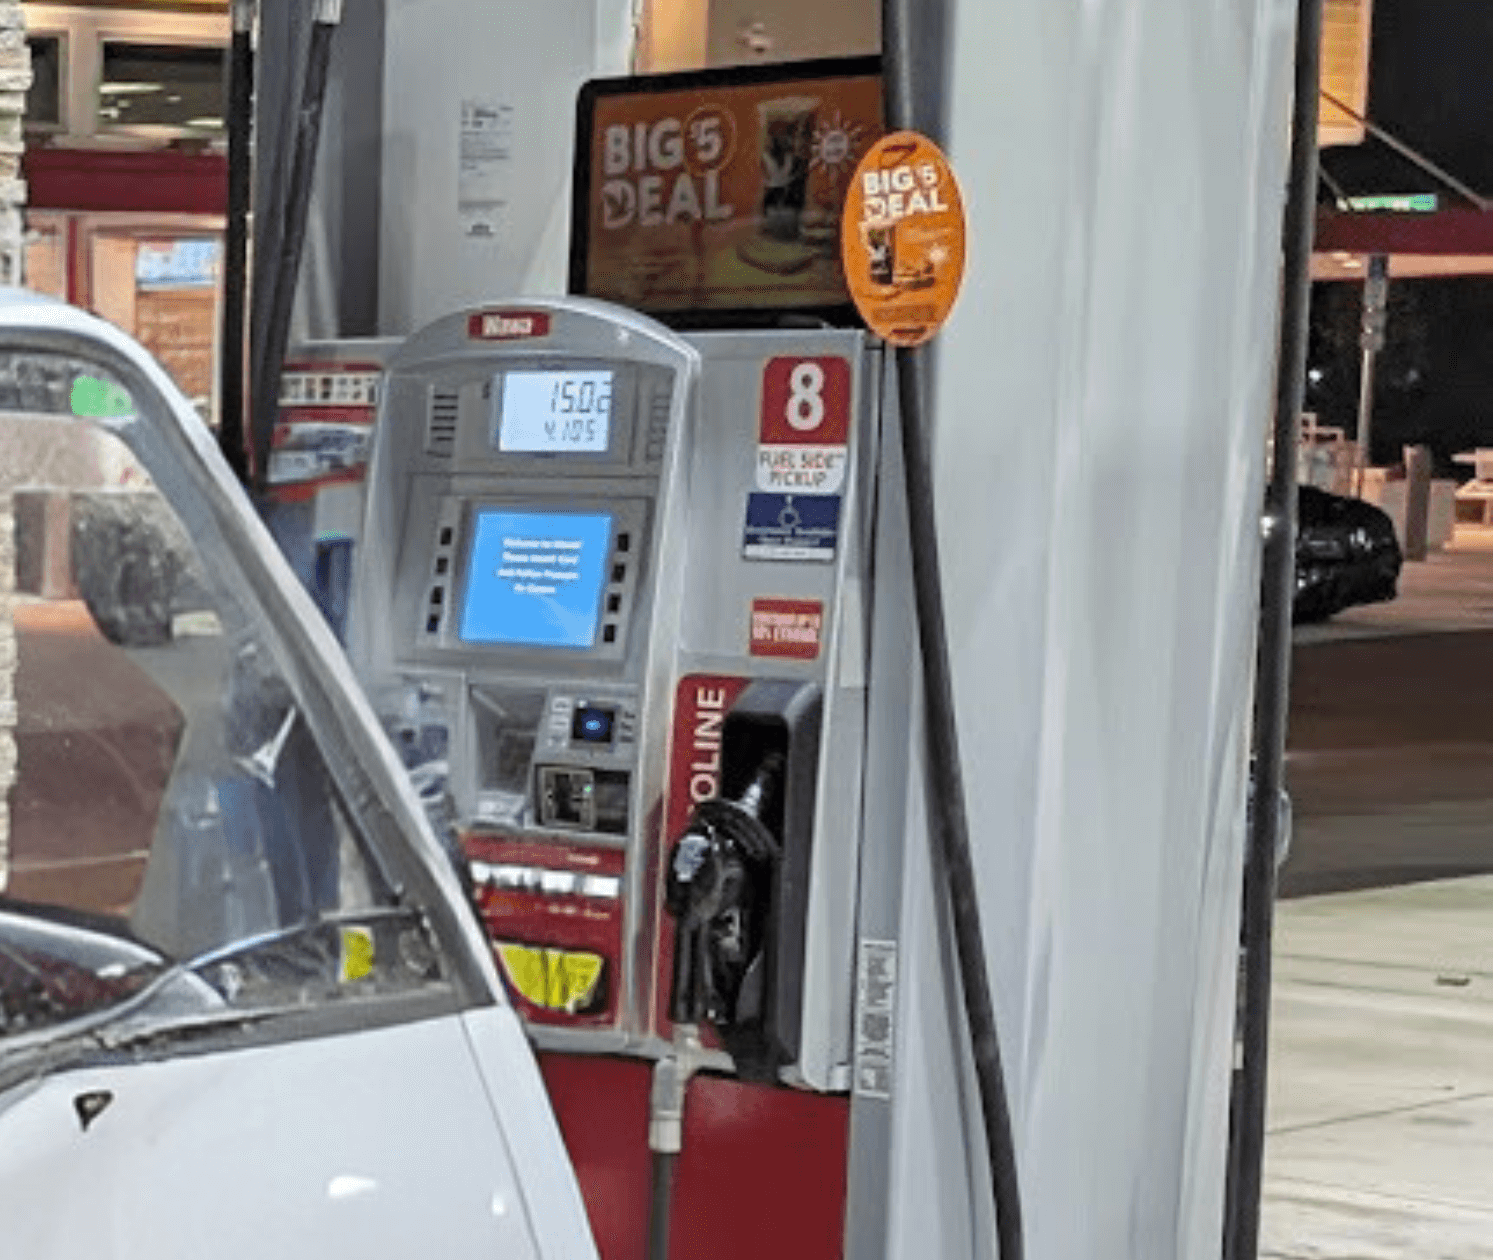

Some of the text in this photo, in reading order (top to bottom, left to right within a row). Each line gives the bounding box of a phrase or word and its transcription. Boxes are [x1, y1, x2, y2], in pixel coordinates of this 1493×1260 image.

[604, 117, 684, 174] BIG
[603, 169, 734, 229] DEAL
[863, 166, 914, 195] BIG
[863, 188, 948, 222] DEAL
[786, 362, 825, 431] 8
[687, 686, 726, 815] OLINE
